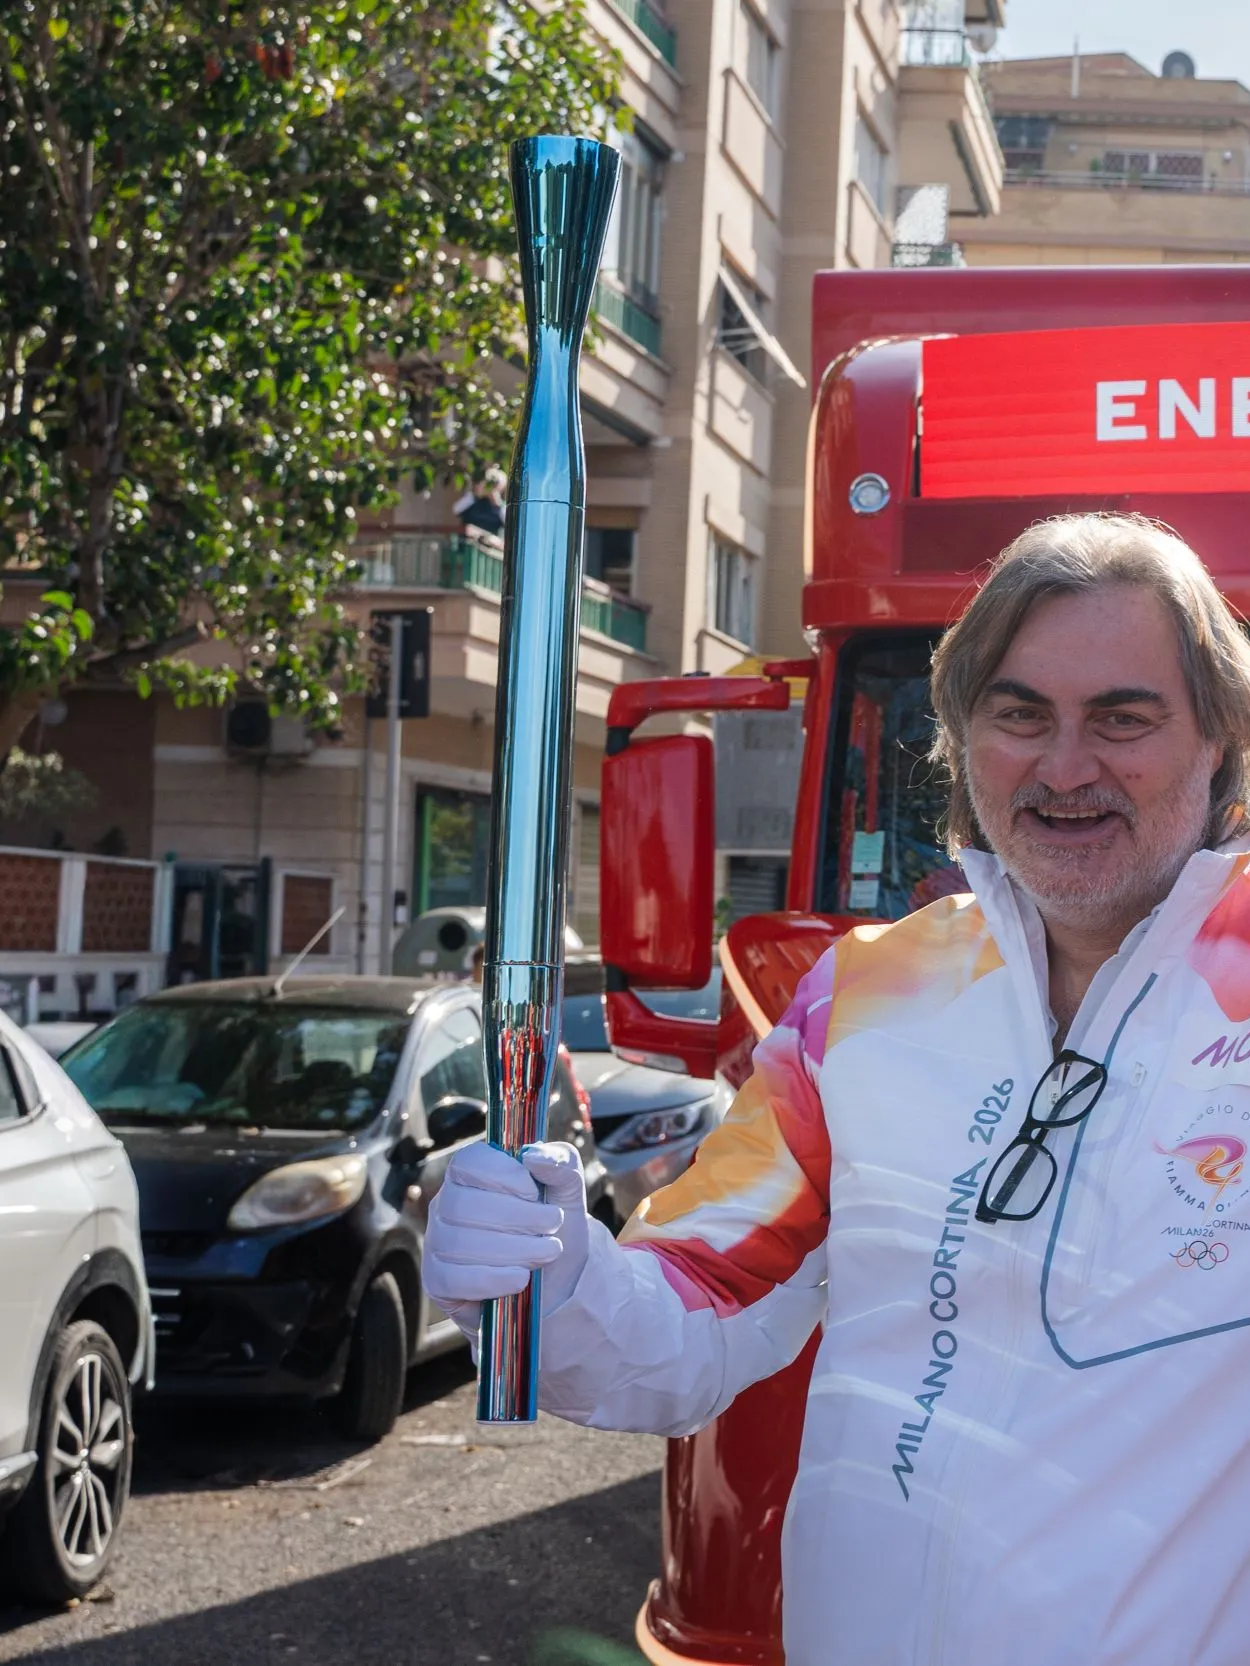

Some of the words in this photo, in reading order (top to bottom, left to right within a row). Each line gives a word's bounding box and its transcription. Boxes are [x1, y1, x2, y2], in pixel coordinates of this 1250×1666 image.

[892, 1329, 959, 1503] MILANO
[929, 1157, 988, 1323] CORTINA
[967, 1077, 1015, 1147] 2026
[1166, 1160, 1206, 1211] FIAMMA
